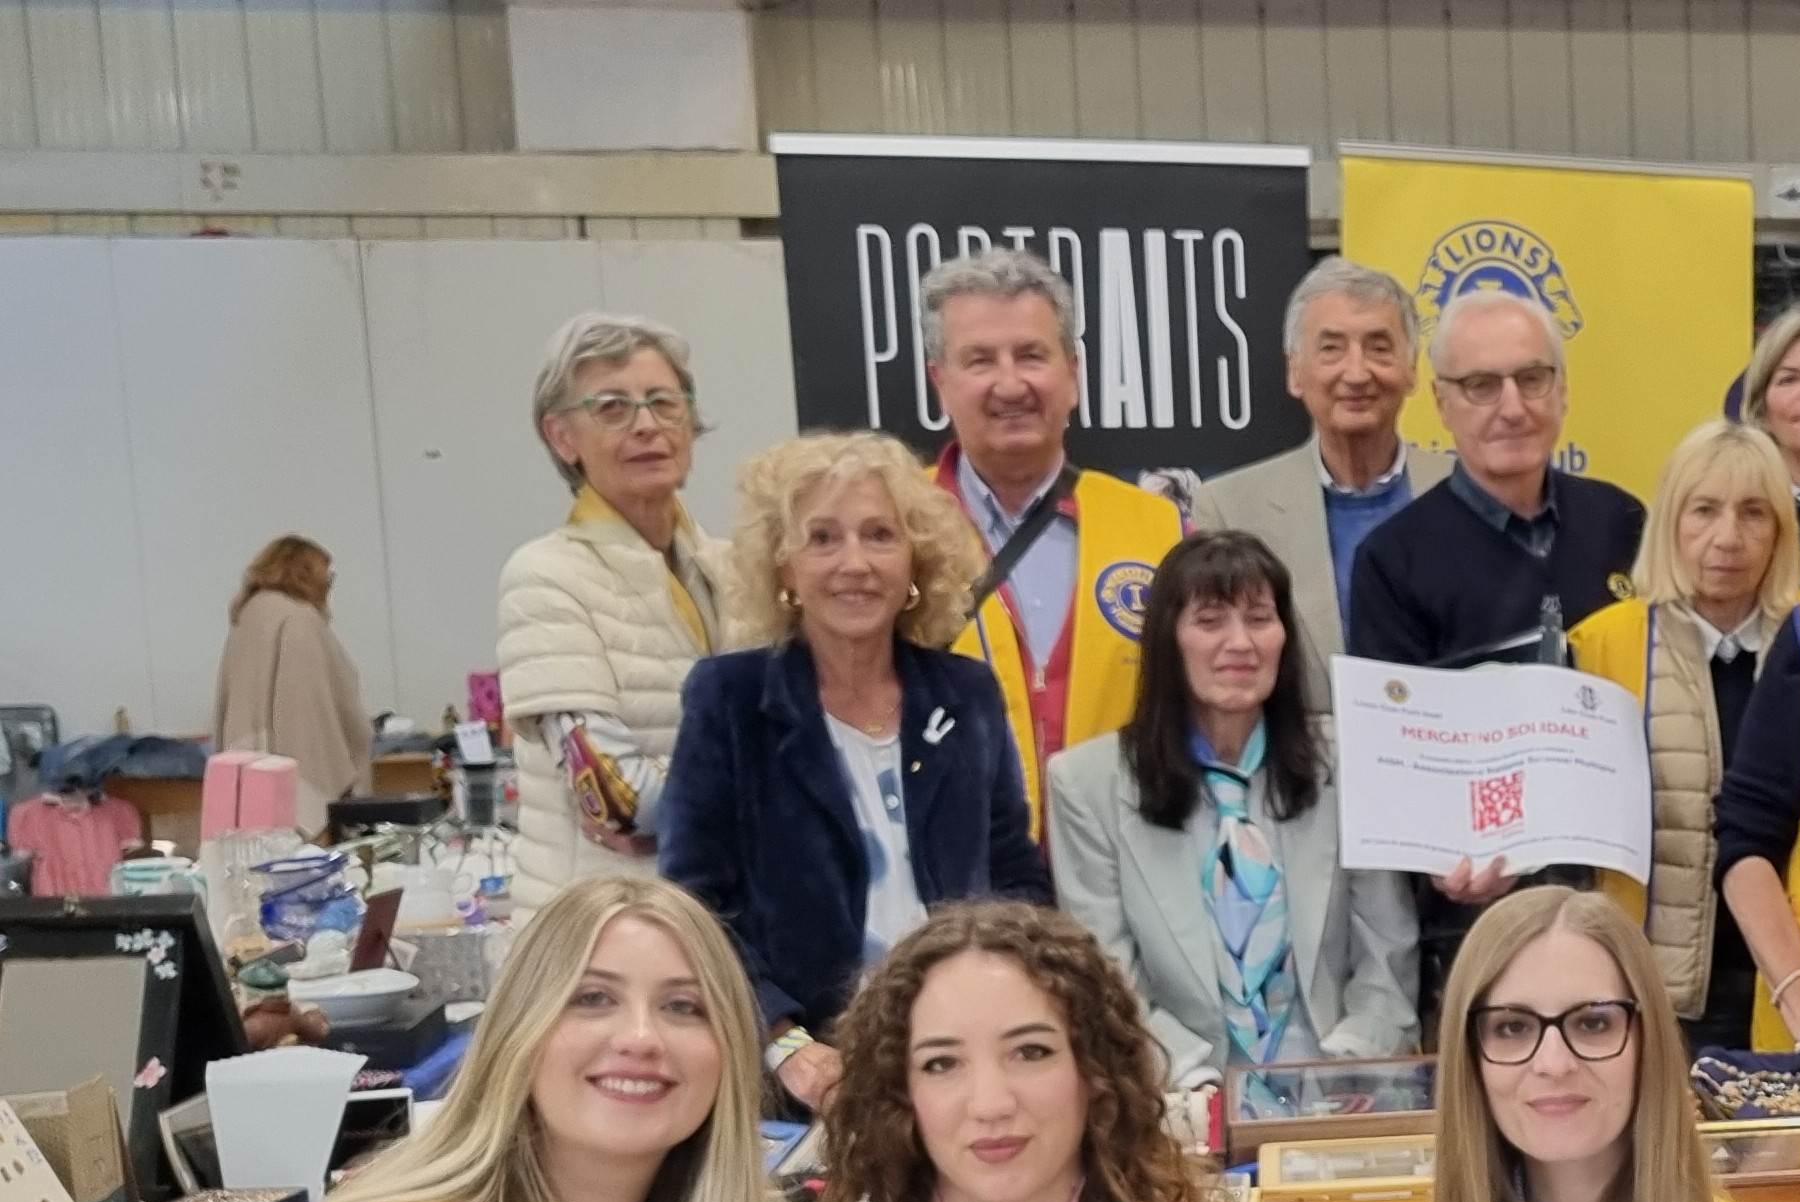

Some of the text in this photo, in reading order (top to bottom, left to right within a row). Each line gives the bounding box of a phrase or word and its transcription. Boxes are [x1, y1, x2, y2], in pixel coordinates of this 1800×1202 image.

[1445, 229, 1543, 269] LIONS
[857, 224, 1252, 431] PORAITS
[1401, 722, 1589, 743] MERCATINO SOLIDALE
